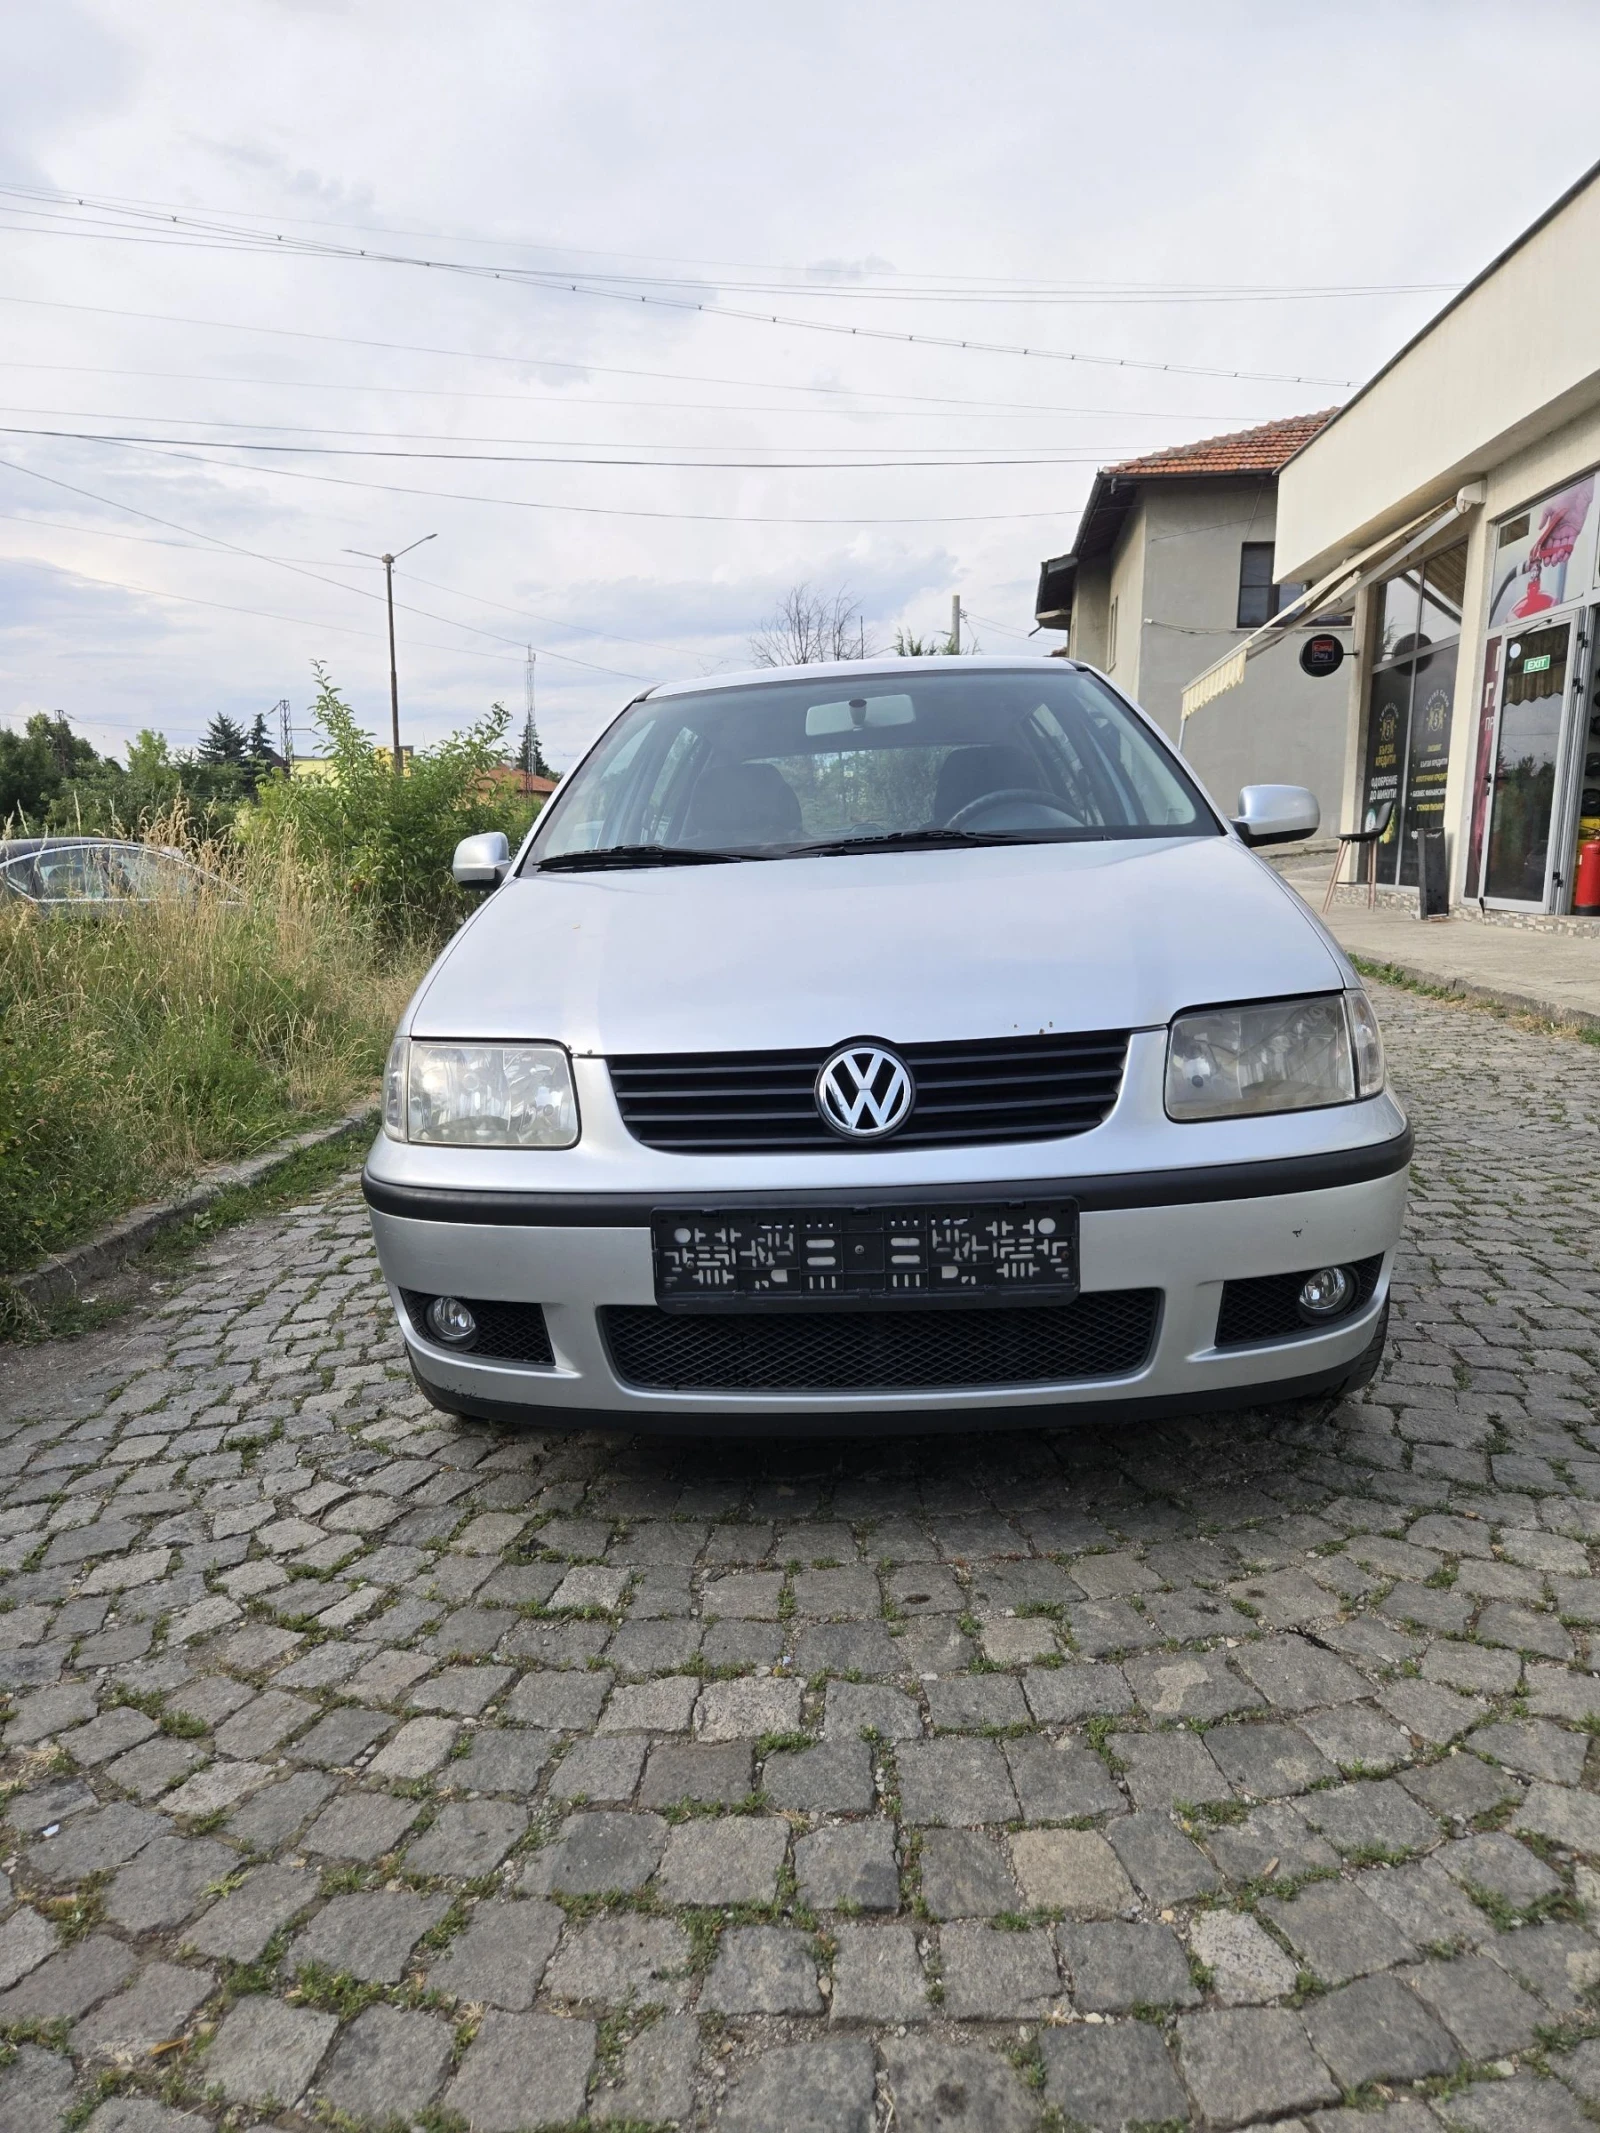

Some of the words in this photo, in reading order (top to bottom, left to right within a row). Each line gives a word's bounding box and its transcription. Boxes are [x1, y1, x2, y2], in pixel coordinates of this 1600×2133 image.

[1313, 652, 1329, 660] Pay
[1527, 659, 1547, 670] EXIT
[819, 1047, 911, 1136] VW
